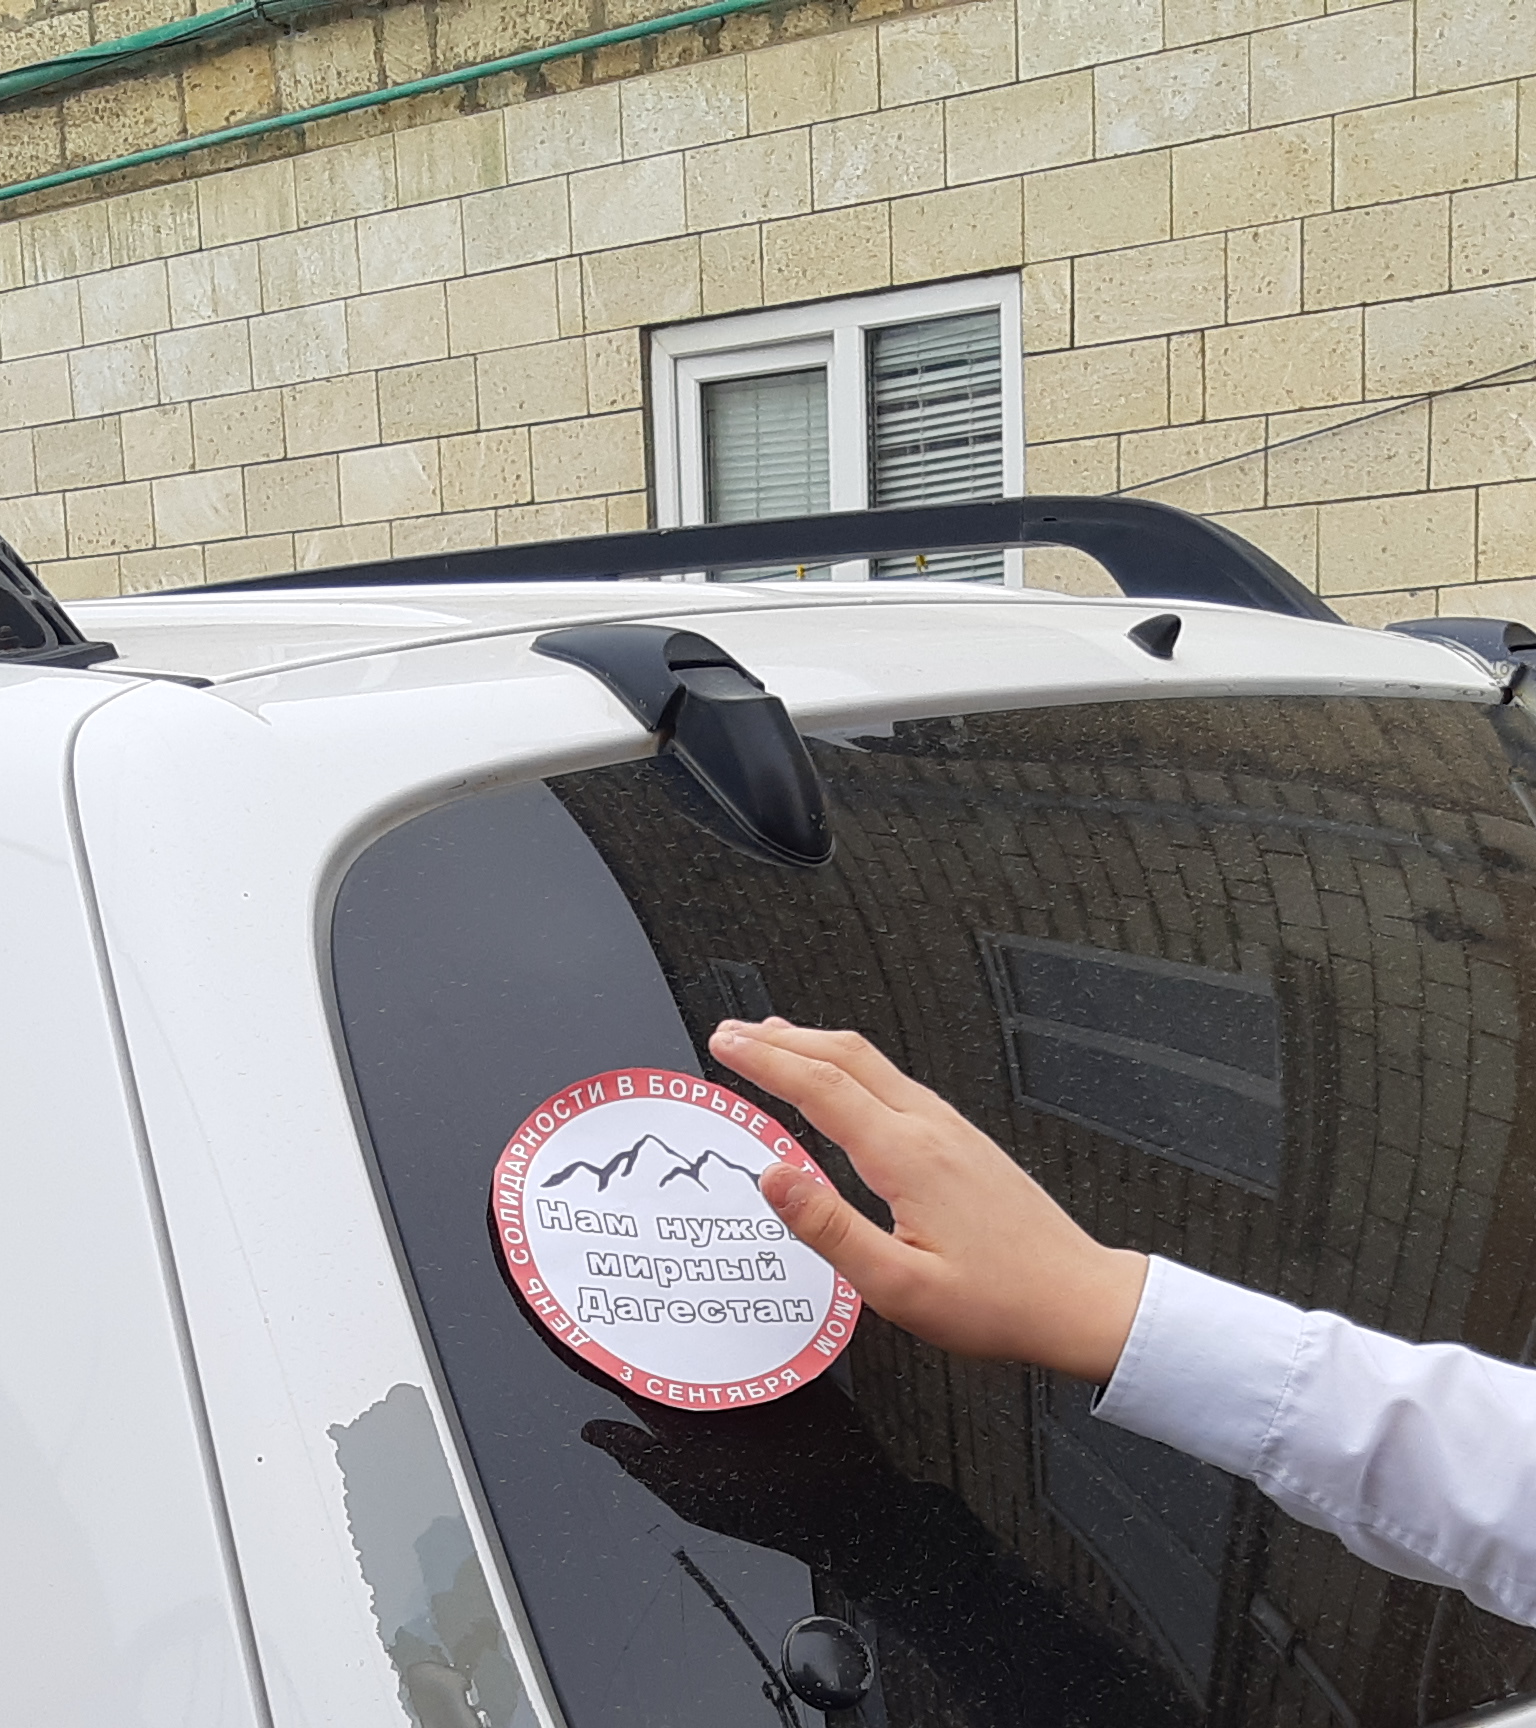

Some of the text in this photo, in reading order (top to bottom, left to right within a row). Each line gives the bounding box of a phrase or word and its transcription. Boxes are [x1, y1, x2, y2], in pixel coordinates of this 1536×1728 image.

[498, 1075, 793, 1348] ДЕНЬ СОЛИДАРНОСТИ В БОРЬБЕ С
[536, 1199, 800, 1248] Нам нуже
[586, 1251, 786, 1288] мирный
[577, 1286, 814, 1325] Дагестан
[619, 1366, 801, 1404] 3 СЕНТЯБРЯ
